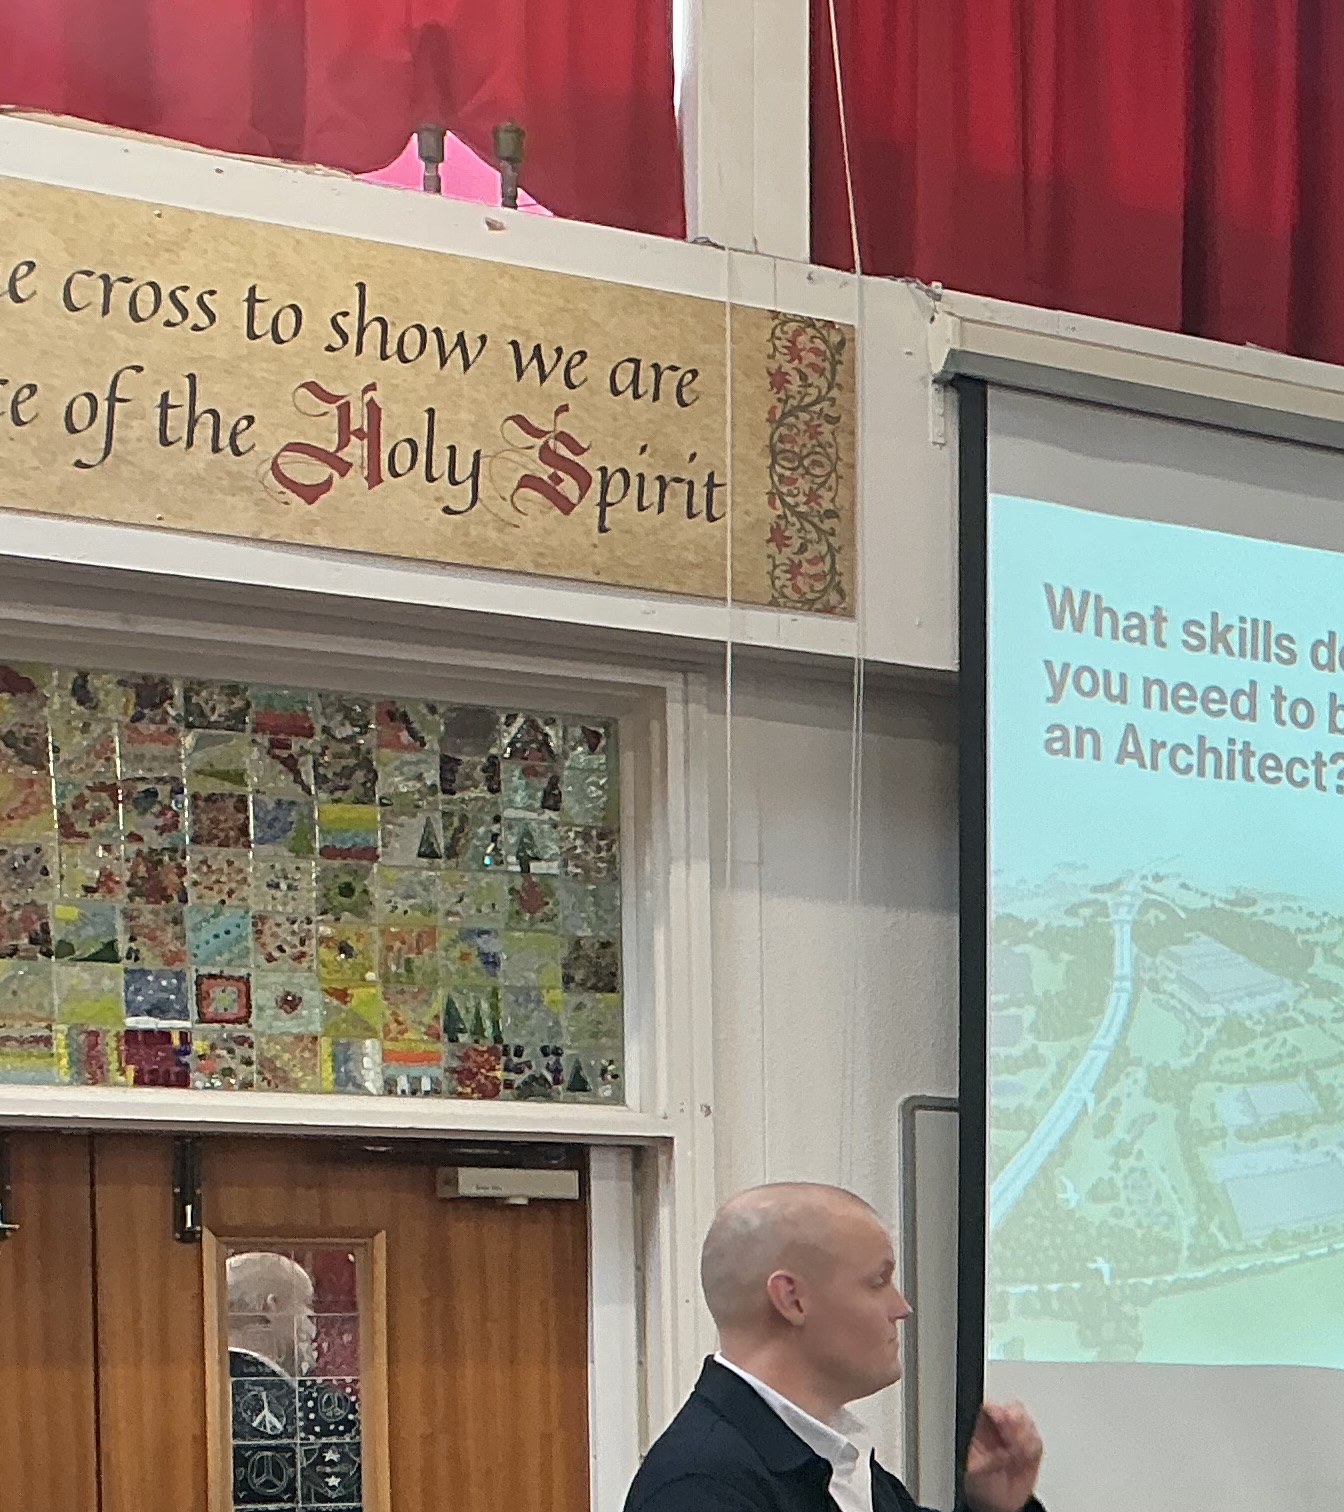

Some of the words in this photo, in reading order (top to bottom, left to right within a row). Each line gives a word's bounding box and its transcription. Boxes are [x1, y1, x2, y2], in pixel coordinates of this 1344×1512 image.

[62, 269, 218, 332] cross
[242, 283, 303, 346] to
[325, 281, 487, 375] show
[507, 333, 588, 391] we
[608, 354, 700, 408] are
[64, 364, 144, 469] of
[155, 372, 256, 457] the
[270, 380, 482, 517] Holy
[504, 402, 727, 533] Spirit
[1043, 582, 1169, 649] What
[1181, 611, 1298, 667] skills
[1043, 659, 1129, 704] you
[1142, 674, 1258, 723] need
[1271, 684, 1315, 731] to
[1043, 721, 1102, 763] an
